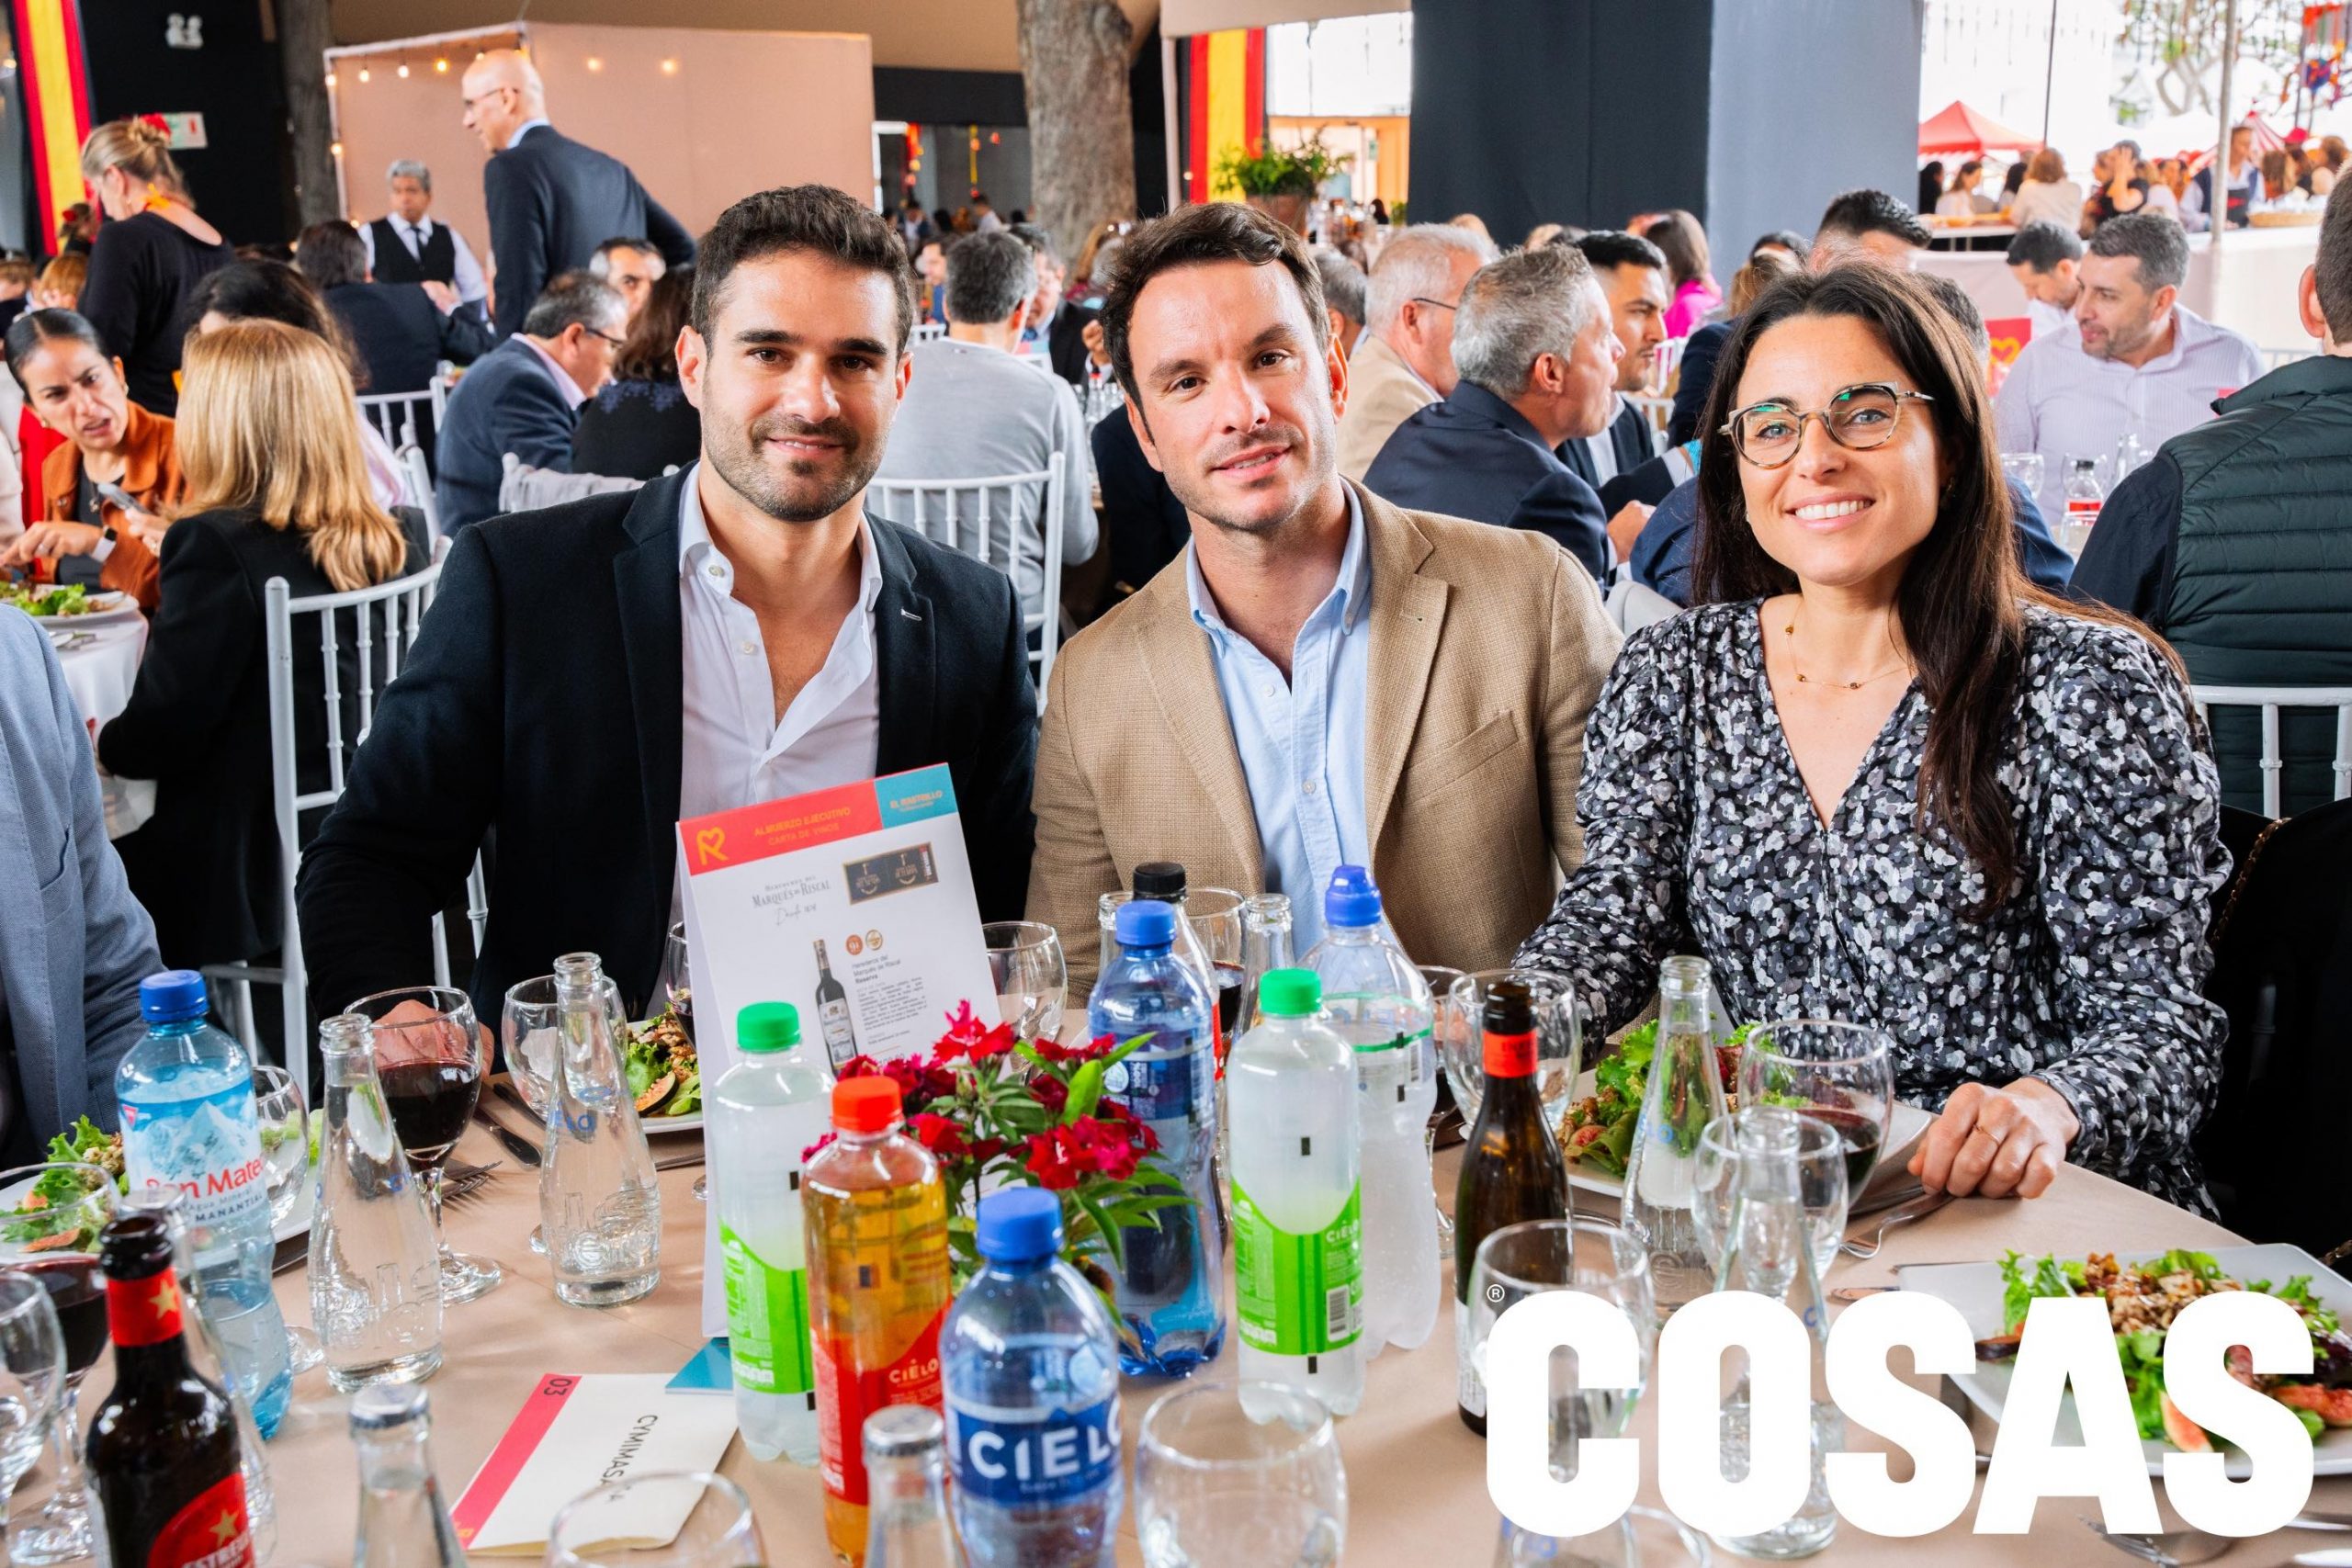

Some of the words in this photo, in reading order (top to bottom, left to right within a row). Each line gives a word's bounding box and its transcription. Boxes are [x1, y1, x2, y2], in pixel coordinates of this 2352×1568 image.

[754, 818, 803, 837] ALMUERZO
[804, 807, 851, 826] EJECUTIVO
[768, 832, 797, 846] CARTA
[814, 822, 840, 837] VINOS
[207, 1158, 263, 1196] Mate
[543, 1378, 571, 1396] 03
